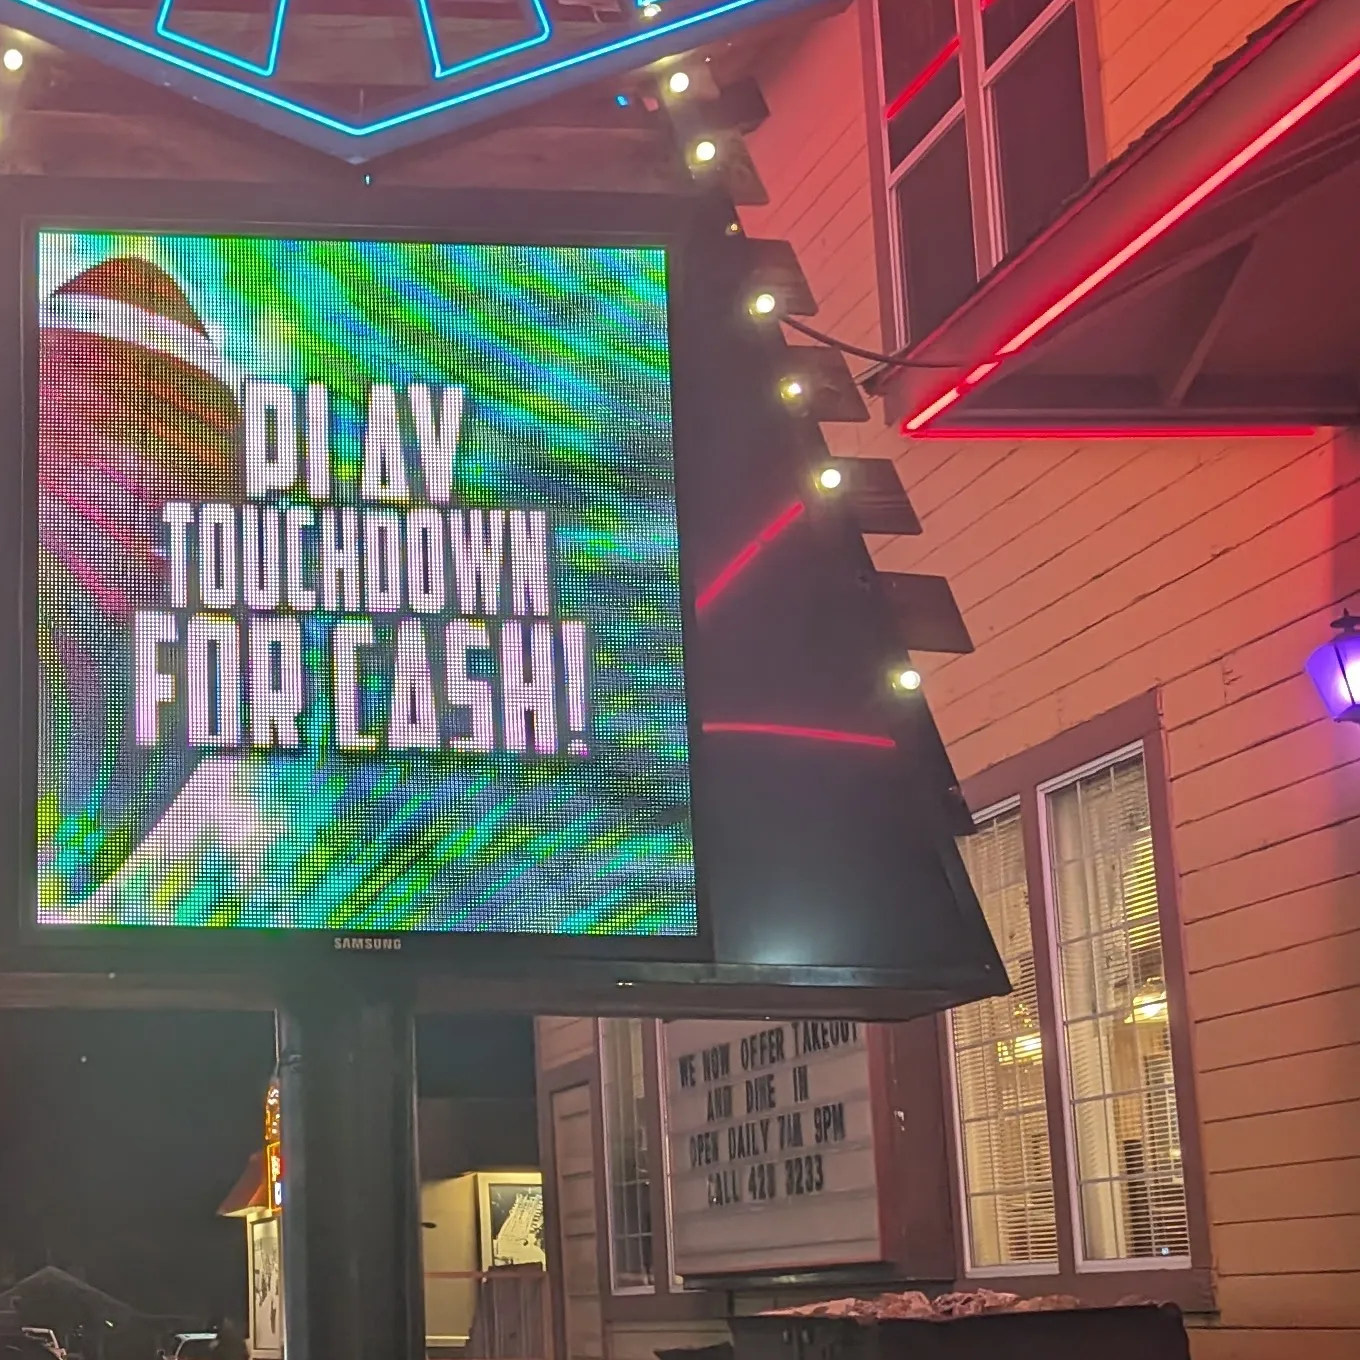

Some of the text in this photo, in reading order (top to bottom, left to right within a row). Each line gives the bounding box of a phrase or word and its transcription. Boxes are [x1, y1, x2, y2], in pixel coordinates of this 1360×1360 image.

[243, 378, 464, 502] PLAY
[162, 501, 549, 616] TOUCHDOWN
[135, 611, 589, 757] FOR CASH!
[334, 937, 402, 950] SAMSUNG
[679, 1021, 858, 1088] WE NOW OFFER TAKEOUT
[745, 1073, 776, 1113] DINE
[793, 1065, 809, 1102] IN
[690, 1131, 718, 1167] OPEN
[728, 1118, 770, 1161] DAILY
[814, 1102, 845, 1144] 9PM
